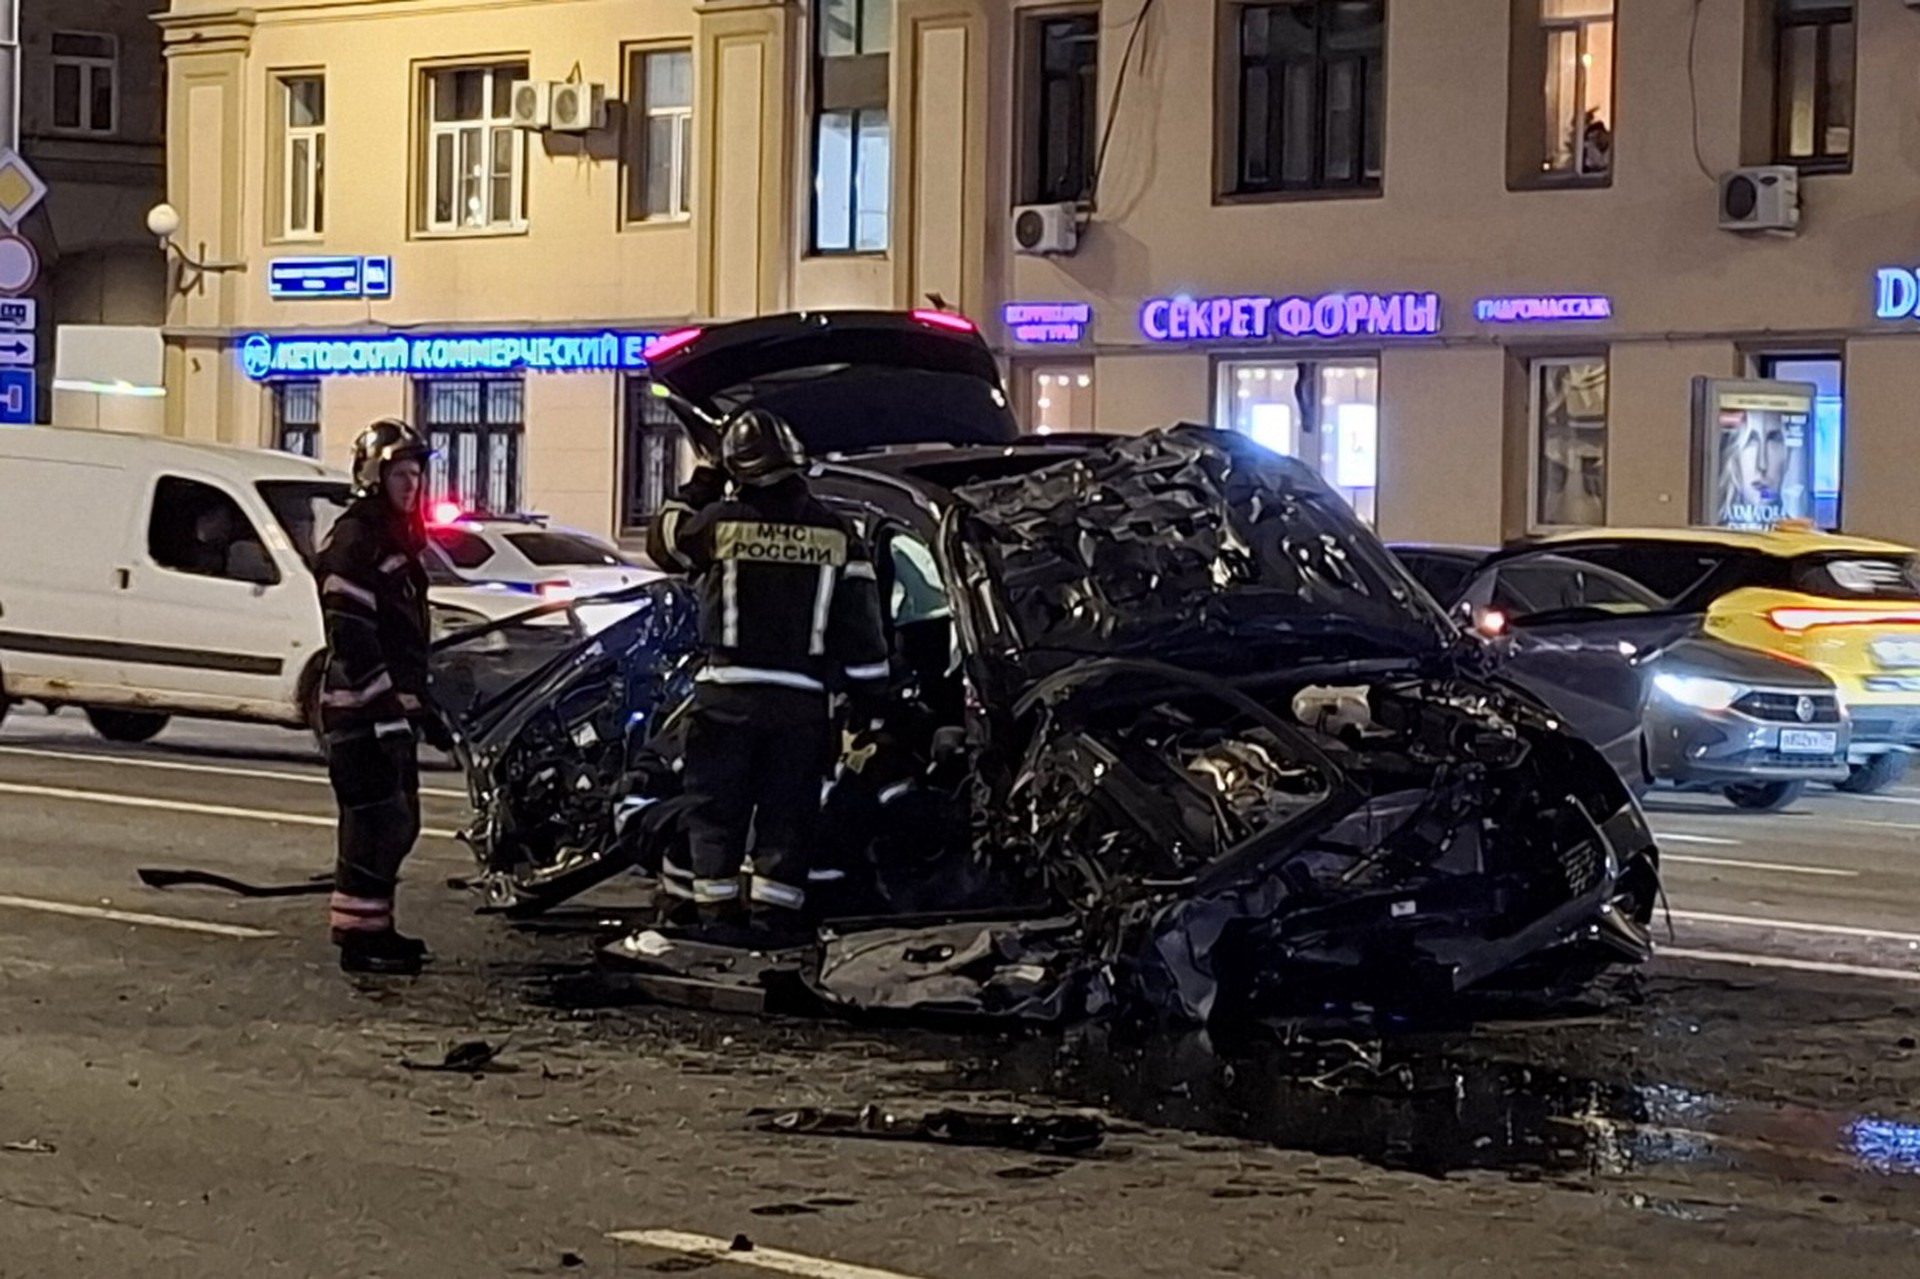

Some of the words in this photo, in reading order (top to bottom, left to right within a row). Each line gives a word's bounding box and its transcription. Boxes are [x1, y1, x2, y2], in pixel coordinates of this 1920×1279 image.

[1143, 298, 1272, 338] СЕКРЕТ
[1278, 294, 1437, 336] ФОРМЫ
[412, 332, 618, 369] КОММЕРЧЕСКИЙ
[757, 524, 806, 542] МЧС
[732, 541, 832, 563] РОССИИ
